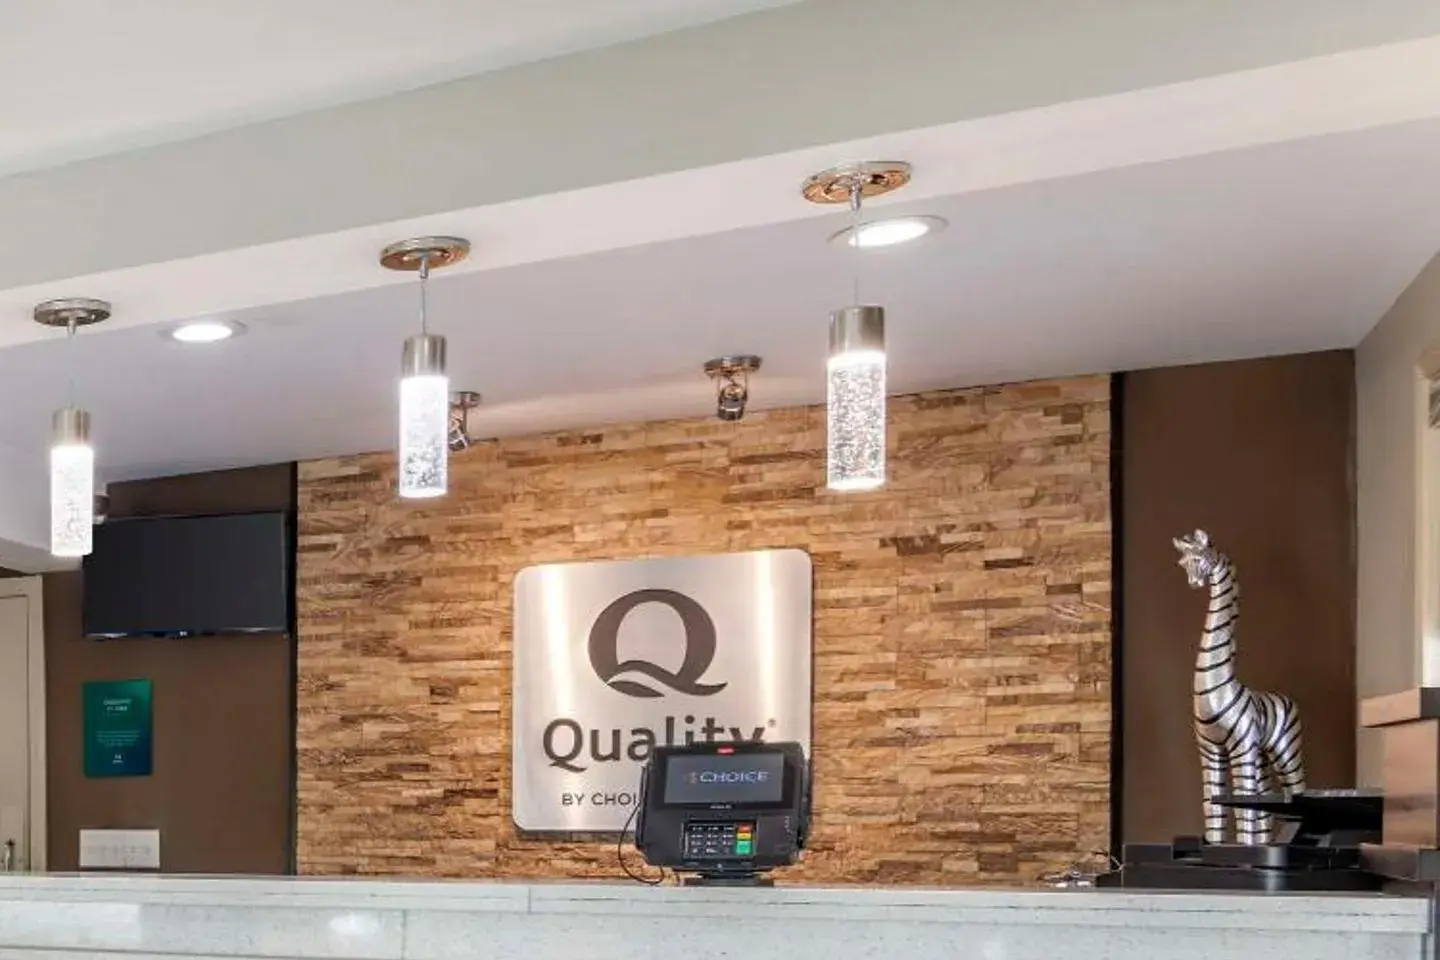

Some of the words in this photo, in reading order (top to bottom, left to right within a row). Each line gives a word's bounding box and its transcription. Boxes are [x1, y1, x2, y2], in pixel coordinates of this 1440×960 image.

[542, 715, 765, 773] Qualit
[699, 770, 769, 783] CHOICE
[561, 792, 585, 805] BY
[591, 792, 637, 805] CHOI
